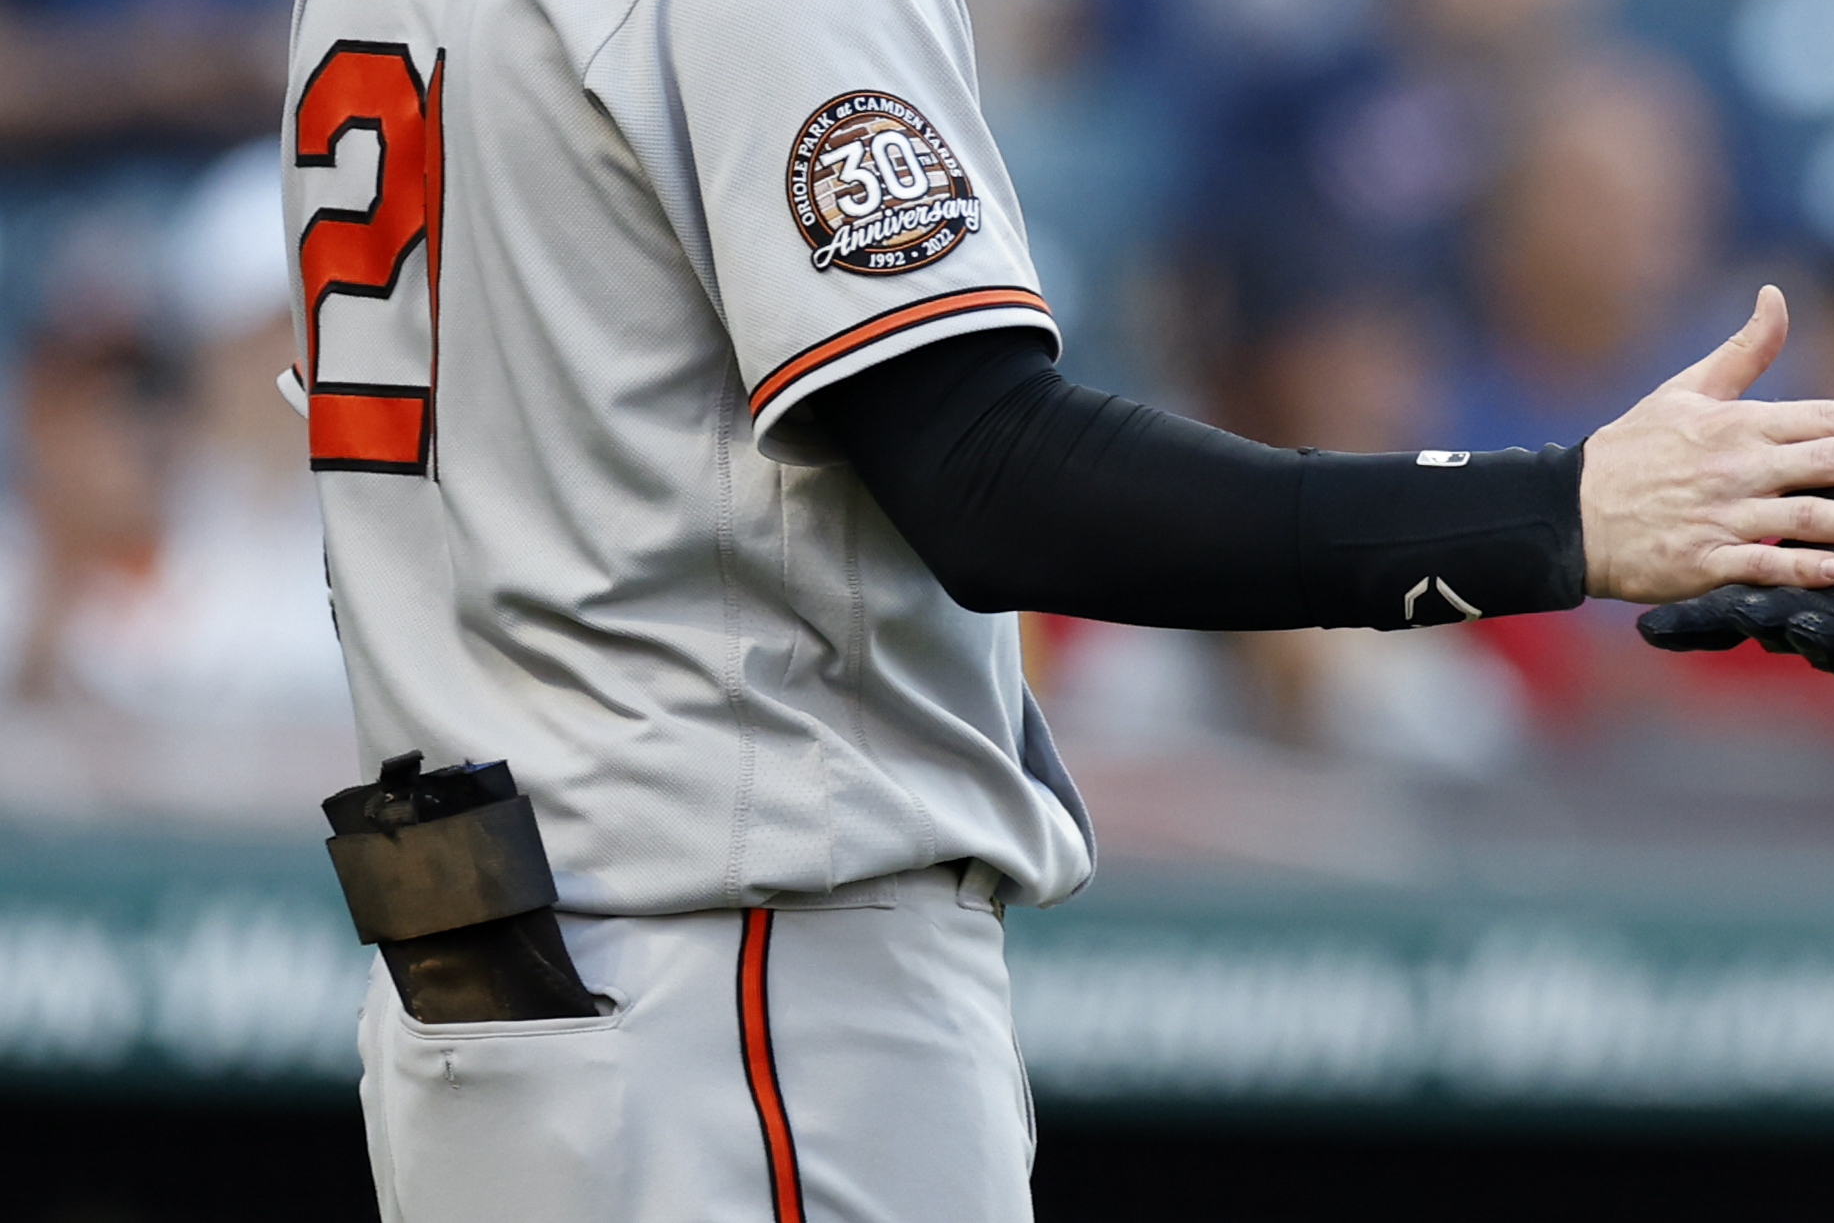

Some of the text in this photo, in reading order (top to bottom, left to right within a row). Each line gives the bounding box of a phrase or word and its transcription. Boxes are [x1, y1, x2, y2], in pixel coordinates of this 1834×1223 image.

[793, 96, 962, 227] ORIOLE PARK at CAMDEN YARDS
[811, 195, 982, 269] Anniversary
[868, 228, 955, 268] 1992 2022
